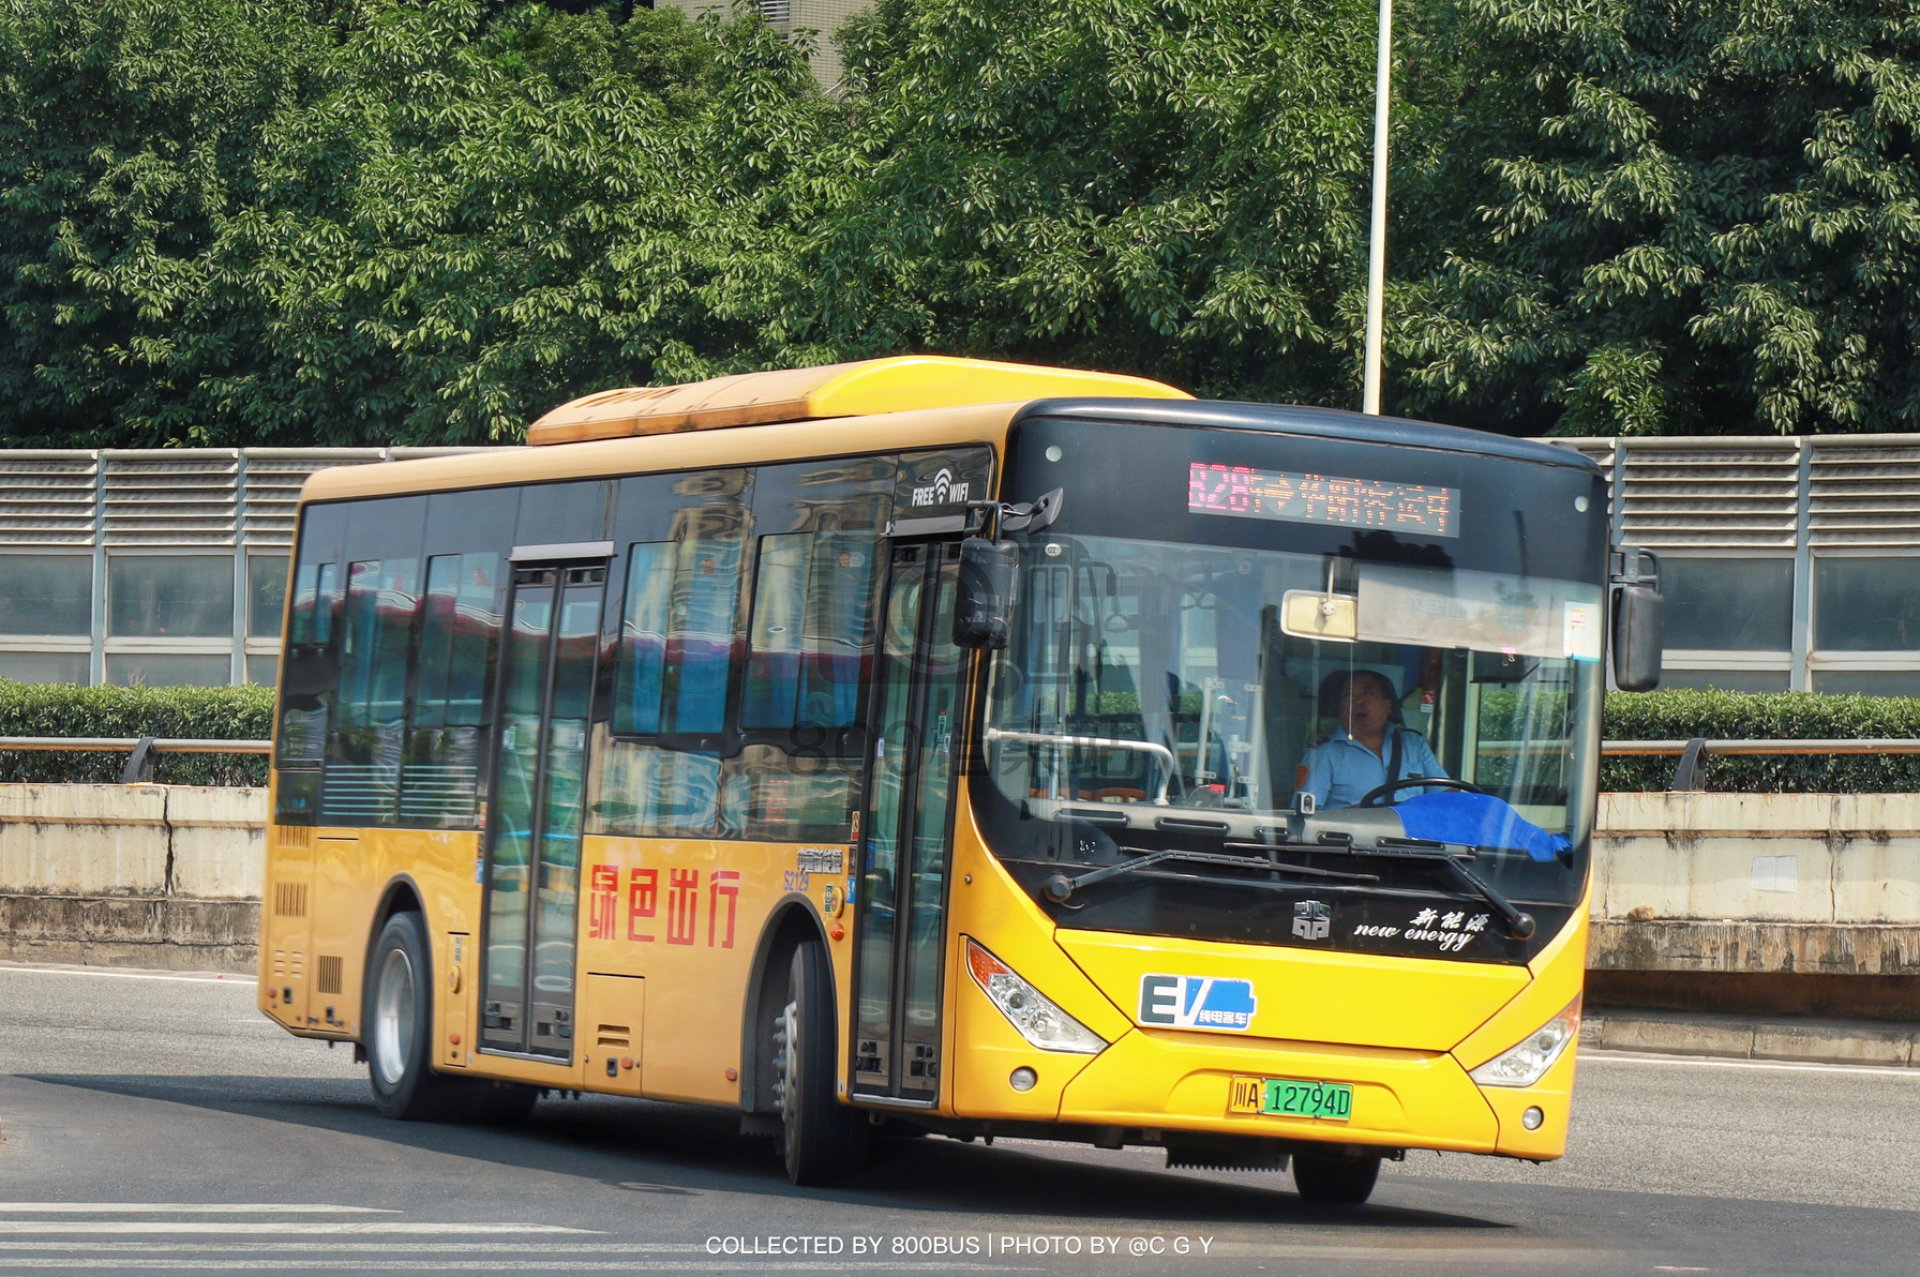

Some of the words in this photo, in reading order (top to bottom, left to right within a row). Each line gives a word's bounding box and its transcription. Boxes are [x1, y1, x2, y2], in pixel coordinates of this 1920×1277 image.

[911, 487, 935, 507] FREE
[949, 482, 970, 503] WIFI
[589, 864, 740, 949] 绿色出行
[1409, 907, 1490, 932] 新能源
[1353, 924, 1401, 938] new
[1404, 928, 1475, 952] energy
[1140, 975, 1214, 1025] EV
